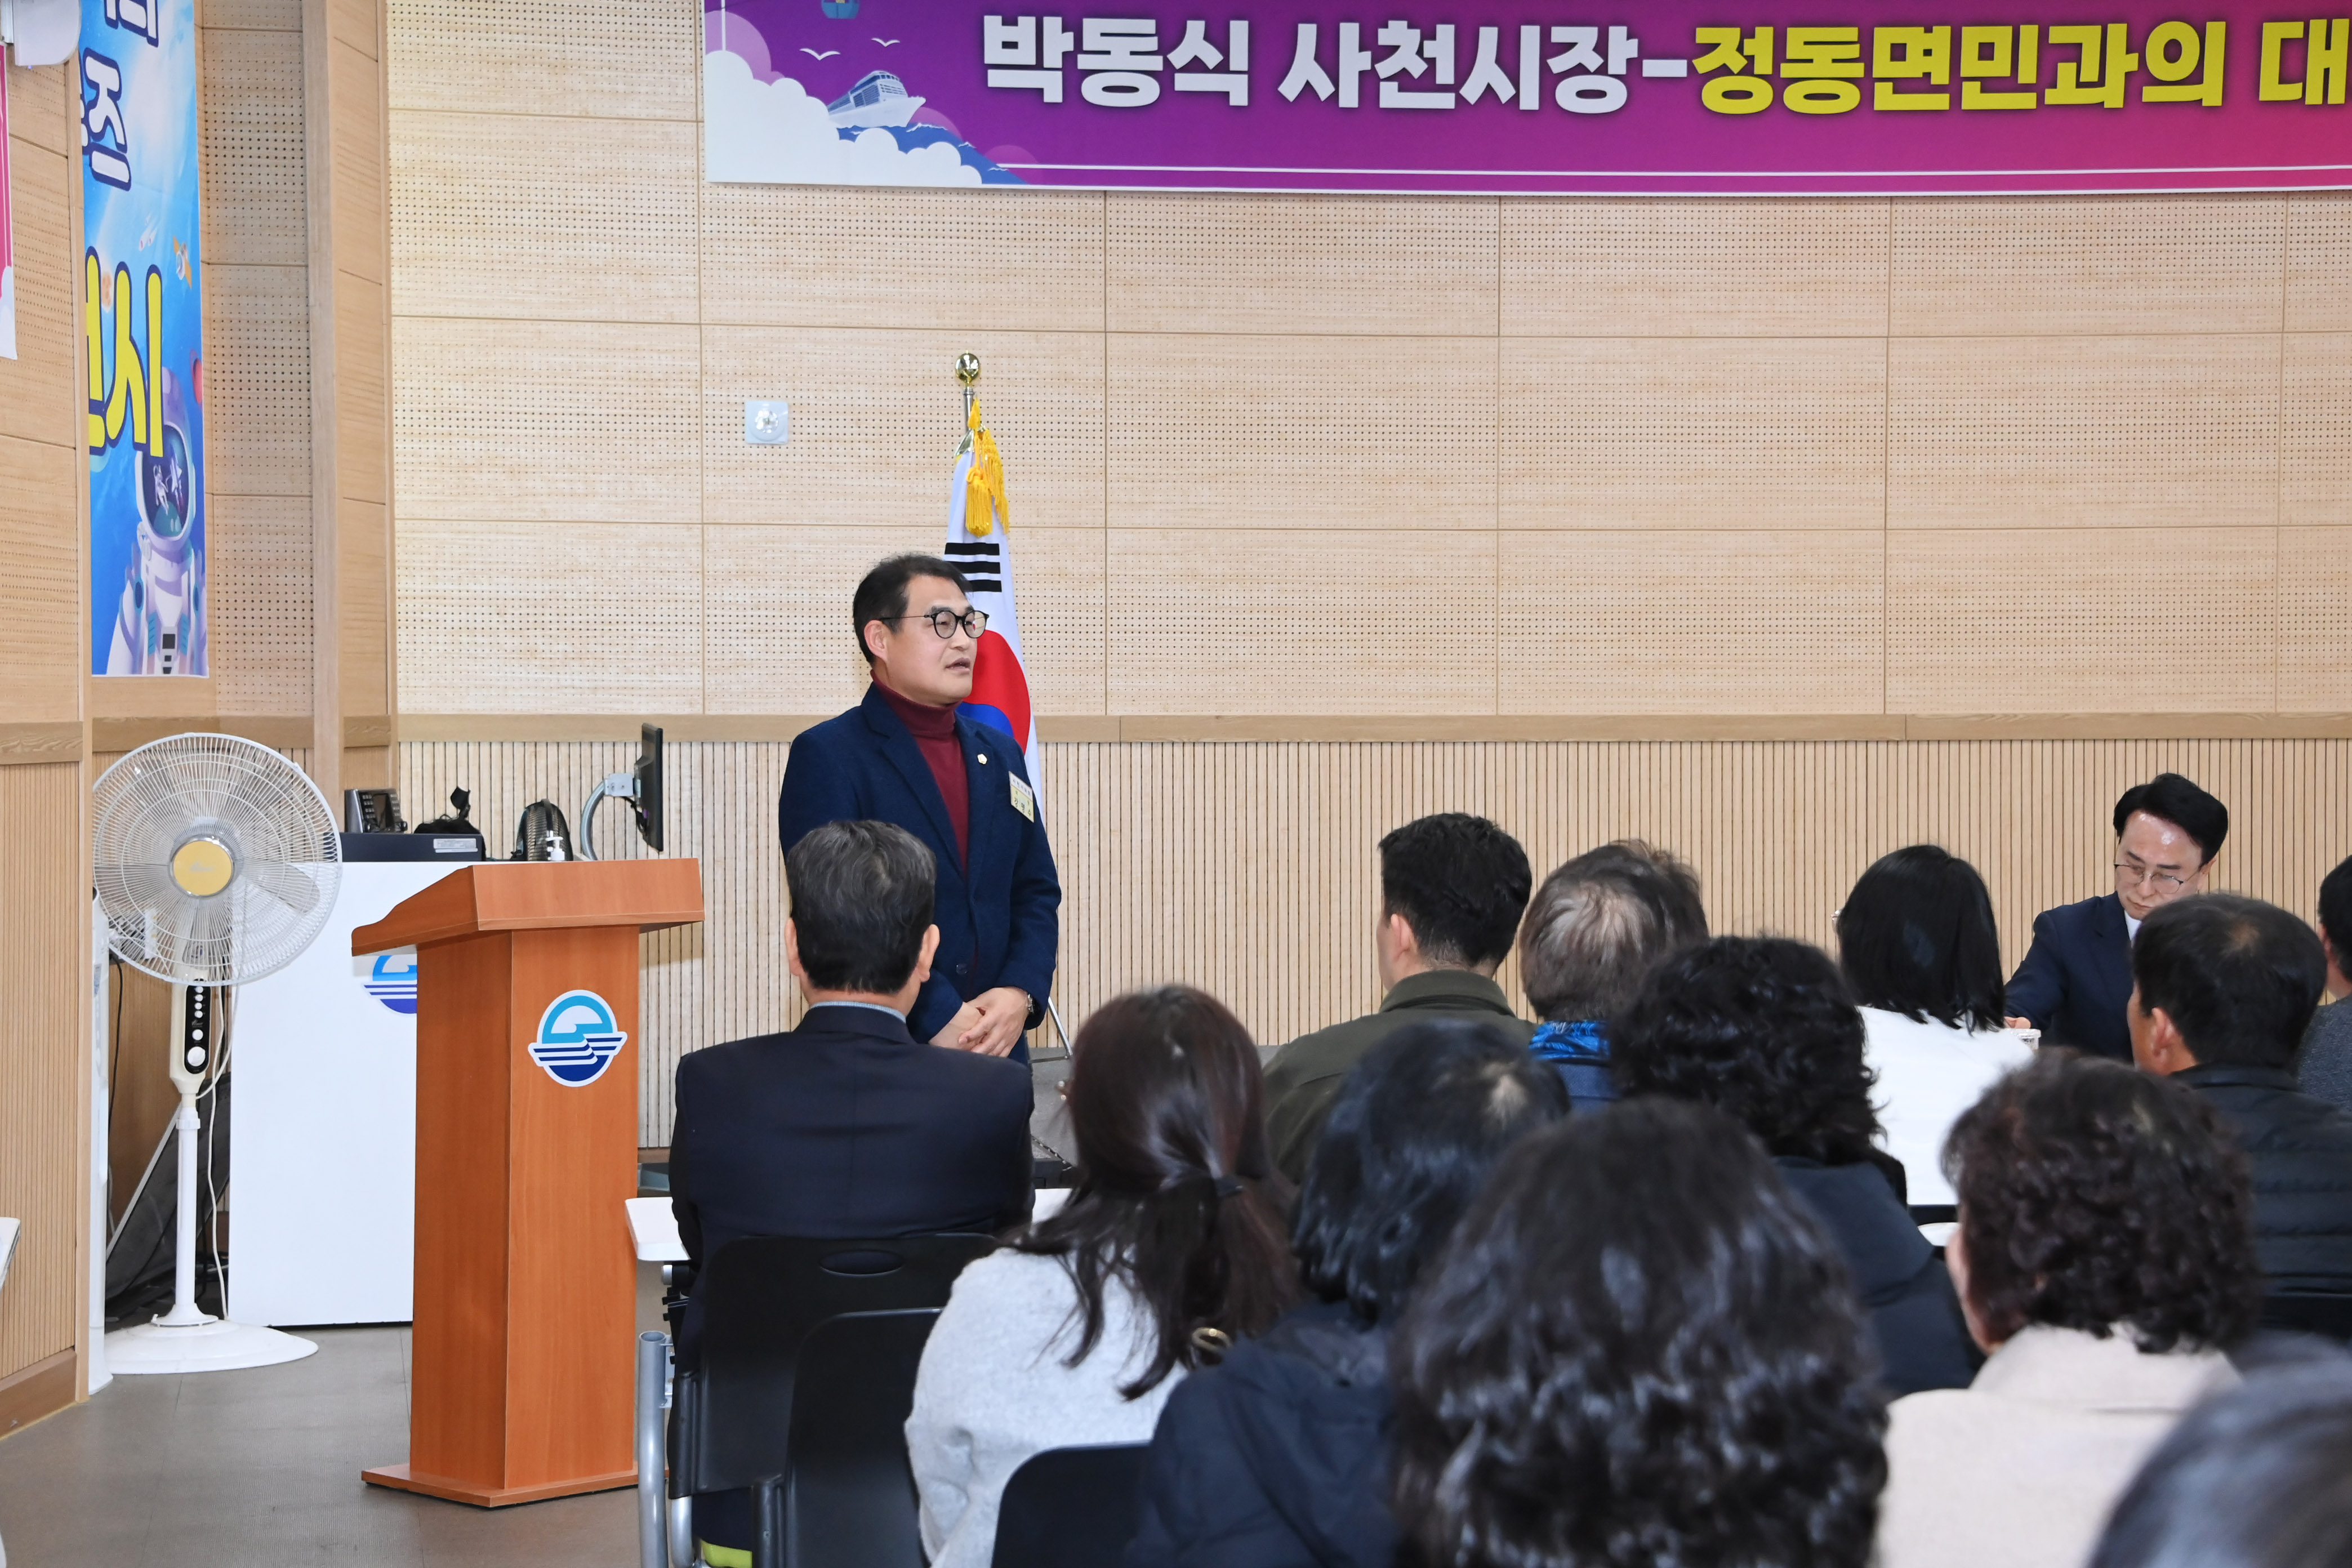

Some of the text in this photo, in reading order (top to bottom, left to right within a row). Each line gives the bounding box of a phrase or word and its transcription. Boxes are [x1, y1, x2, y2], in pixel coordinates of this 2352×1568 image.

[984, 15, 2350, 115] 박동식 사천시장-정동면민과의 대
